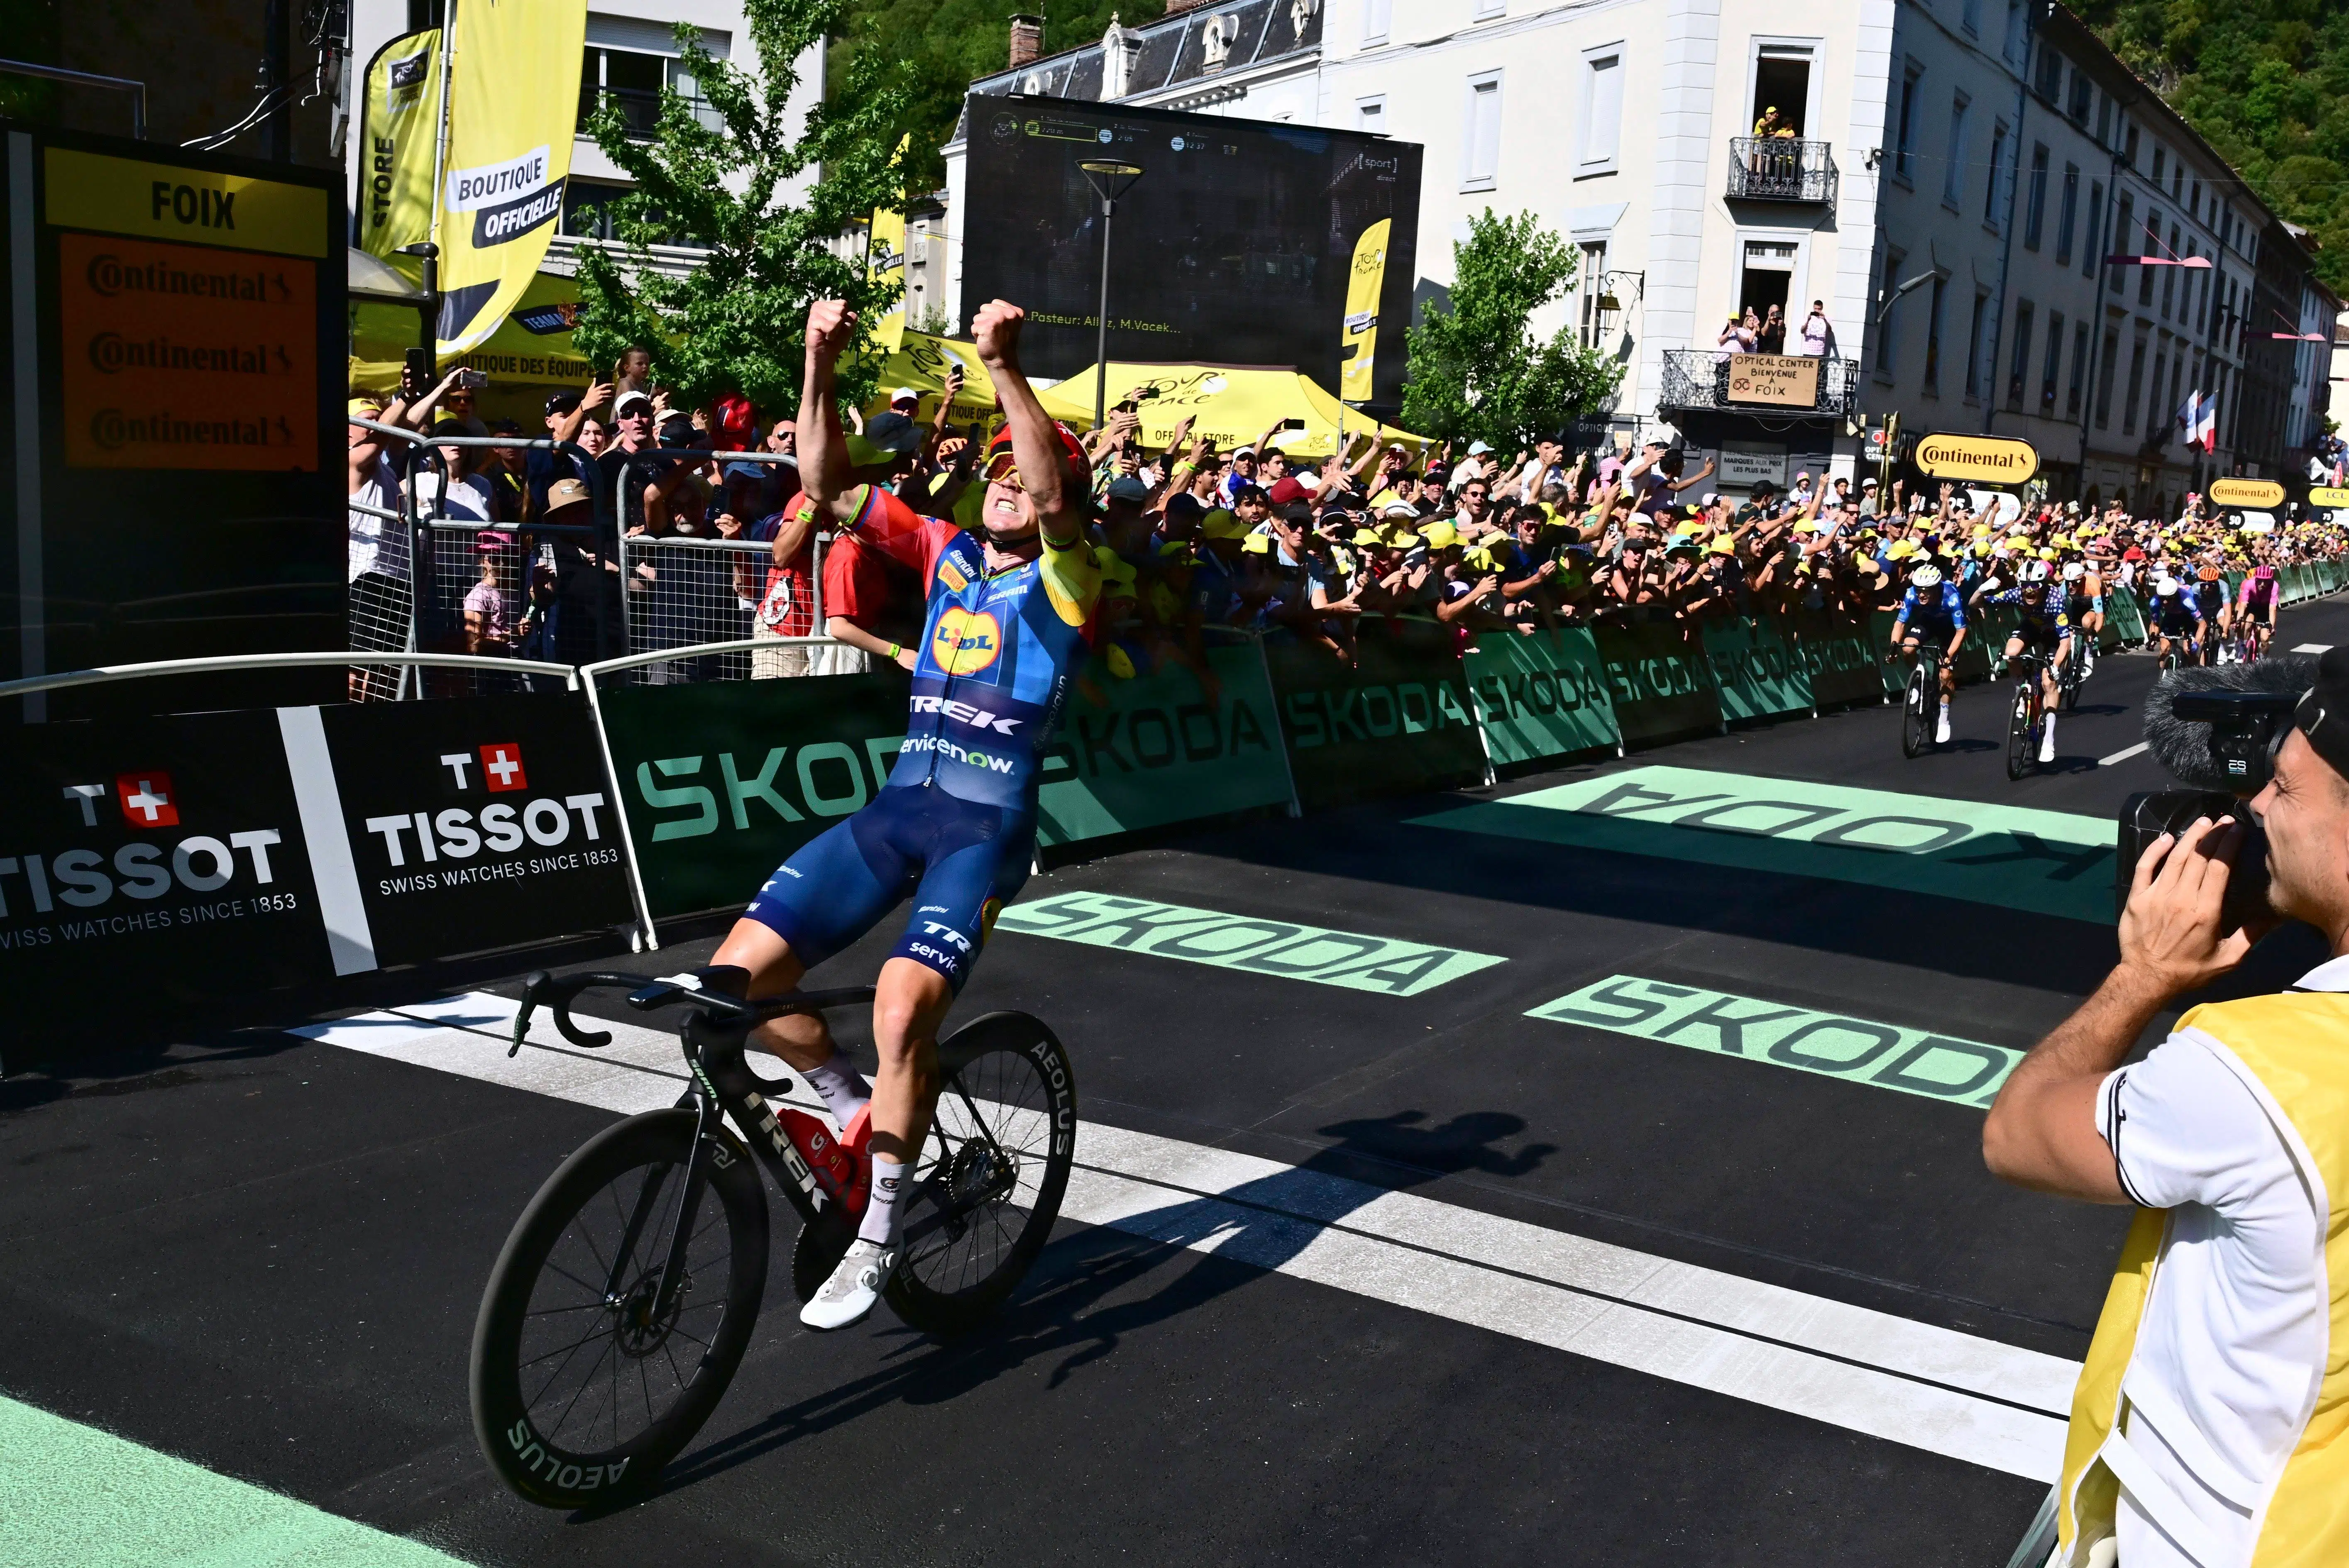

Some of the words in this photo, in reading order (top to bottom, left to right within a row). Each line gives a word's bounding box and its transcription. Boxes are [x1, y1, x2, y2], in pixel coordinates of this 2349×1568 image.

[373, 137, 394, 228] STORE
[458, 157, 543, 201] BOUTIQUE
[151, 181, 236, 231] FOIX
[485, 186, 562, 238] OFFICIELLE
[88, 254, 266, 302] Continental
[1084, 315, 1115, 330] Allz,
[89, 331, 268, 375] Continental
[520, 357, 544, 373] DES
[1735, 356, 1775, 366] OPTICAL
[1779, 359, 1814, 369] CENTER
[1750, 368, 1797, 379] BIENVENUE
[933, 403, 975, 420] BTIQUE
[1755, 384, 1786, 396] FOIX
[90, 407, 268, 448] Continental
[1579, 423, 1613, 434] OPTIQUE
[1922, 445, 2014, 468] Continental
[2214, 486, 2269, 498] Continental
[2229, 515, 2241, 525] 50
[949, 549, 978, 579] Santini
[986, 584, 1028, 604] SRAM
[1478, 666, 1607, 723] SKODA
[1607, 655, 1711, 703] SKODA
[1288, 679, 1471, 747] SKODA
[900, 733, 1014, 774] ervicenow
[637, 735, 907, 842] SKO
[365, 792, 604, 867] TISSOT
[1575, 783, 2117, 882] KODA
[379, 874, 437, 896] SWISS
[441, 861, 525, 887] WATCHES
[530, 853, 579, 874] SINCE
[582, 848, 618, 866] 1853
[59, 910, 172, 941] WATCHES
[178, 900, 244, 924] SINCE
[251, 893, 297, 913] 1853
[923, 921, 972, 953] TR
[996, 896, 1460, 994] SKODA
[1545, 979, 2010, 1104] SKOD
[689, 1058, 718, 1099] SRAM
[1030, 1040, 1070, 1157] AEOLUS
[744, 1092, 829, 1213] TREK
[507, 1418, 631, 1490] AEOLUS
